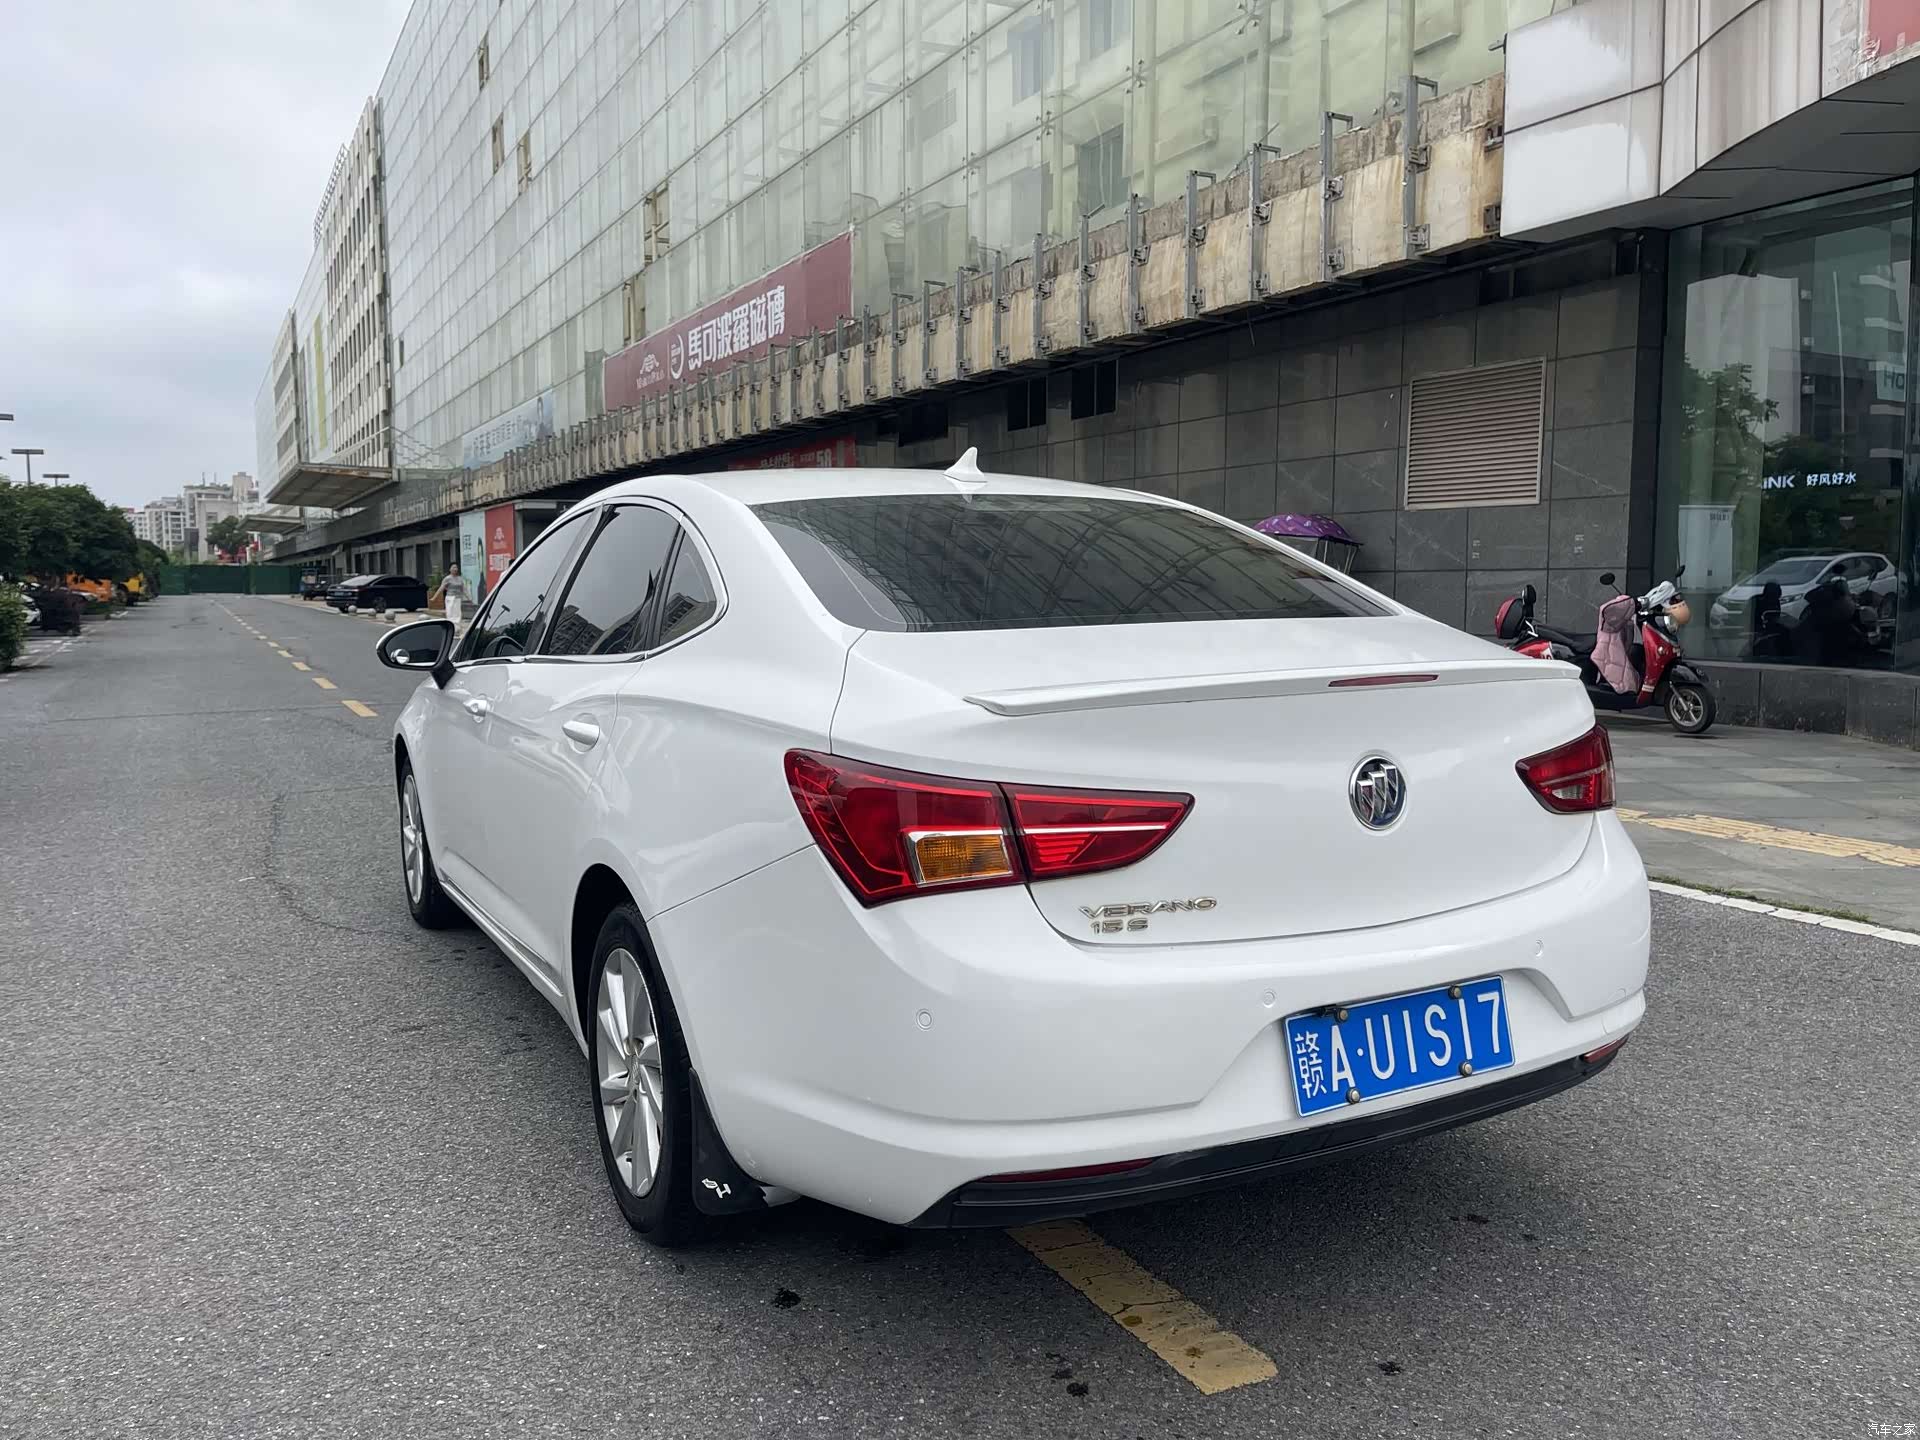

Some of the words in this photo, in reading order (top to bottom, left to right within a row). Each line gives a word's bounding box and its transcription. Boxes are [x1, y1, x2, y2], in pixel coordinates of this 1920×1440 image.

[1761, 474, 1796, 490] INK
[1806, 471, 1857, 487] 好风好水
[1078, 896, 1218, 919] VERANO
